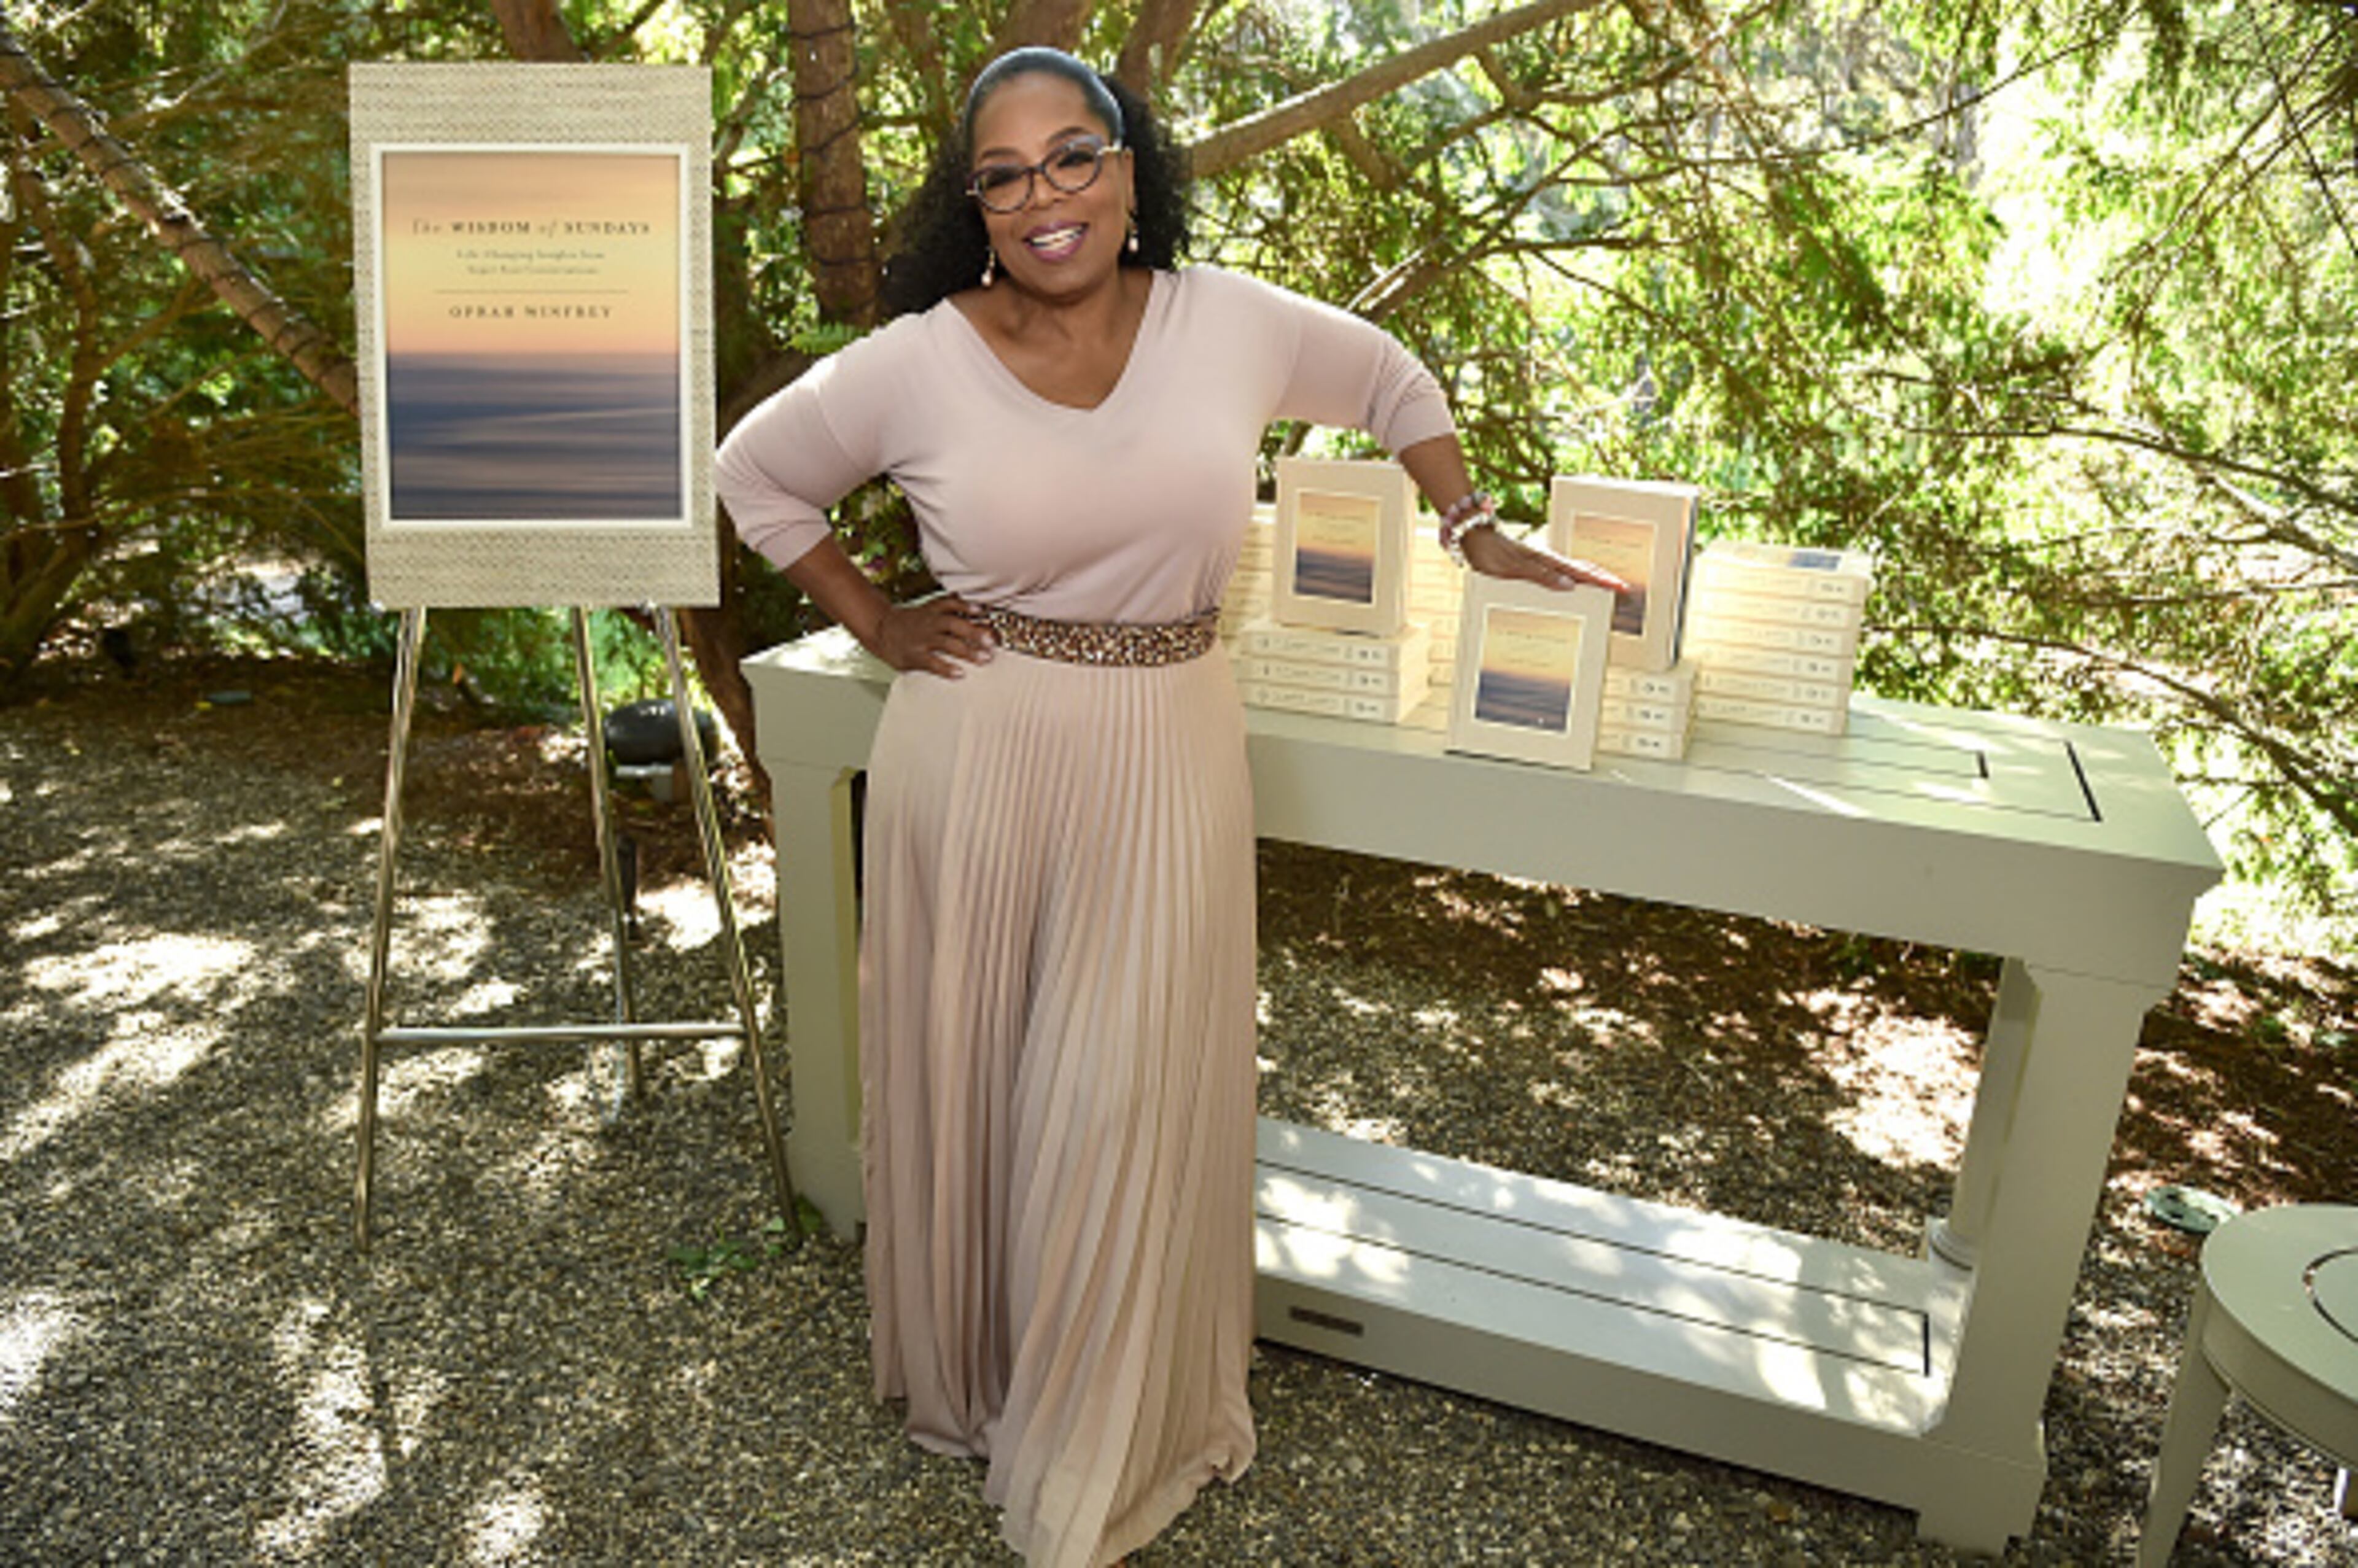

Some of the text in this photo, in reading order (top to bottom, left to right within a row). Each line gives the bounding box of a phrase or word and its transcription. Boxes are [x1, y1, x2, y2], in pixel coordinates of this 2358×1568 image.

[450, 221, 531, 235] WISDOM
[564, 221, 650, 235] SUNDAYS
[449, 306, 612, 318] OPRAH WINFREY
